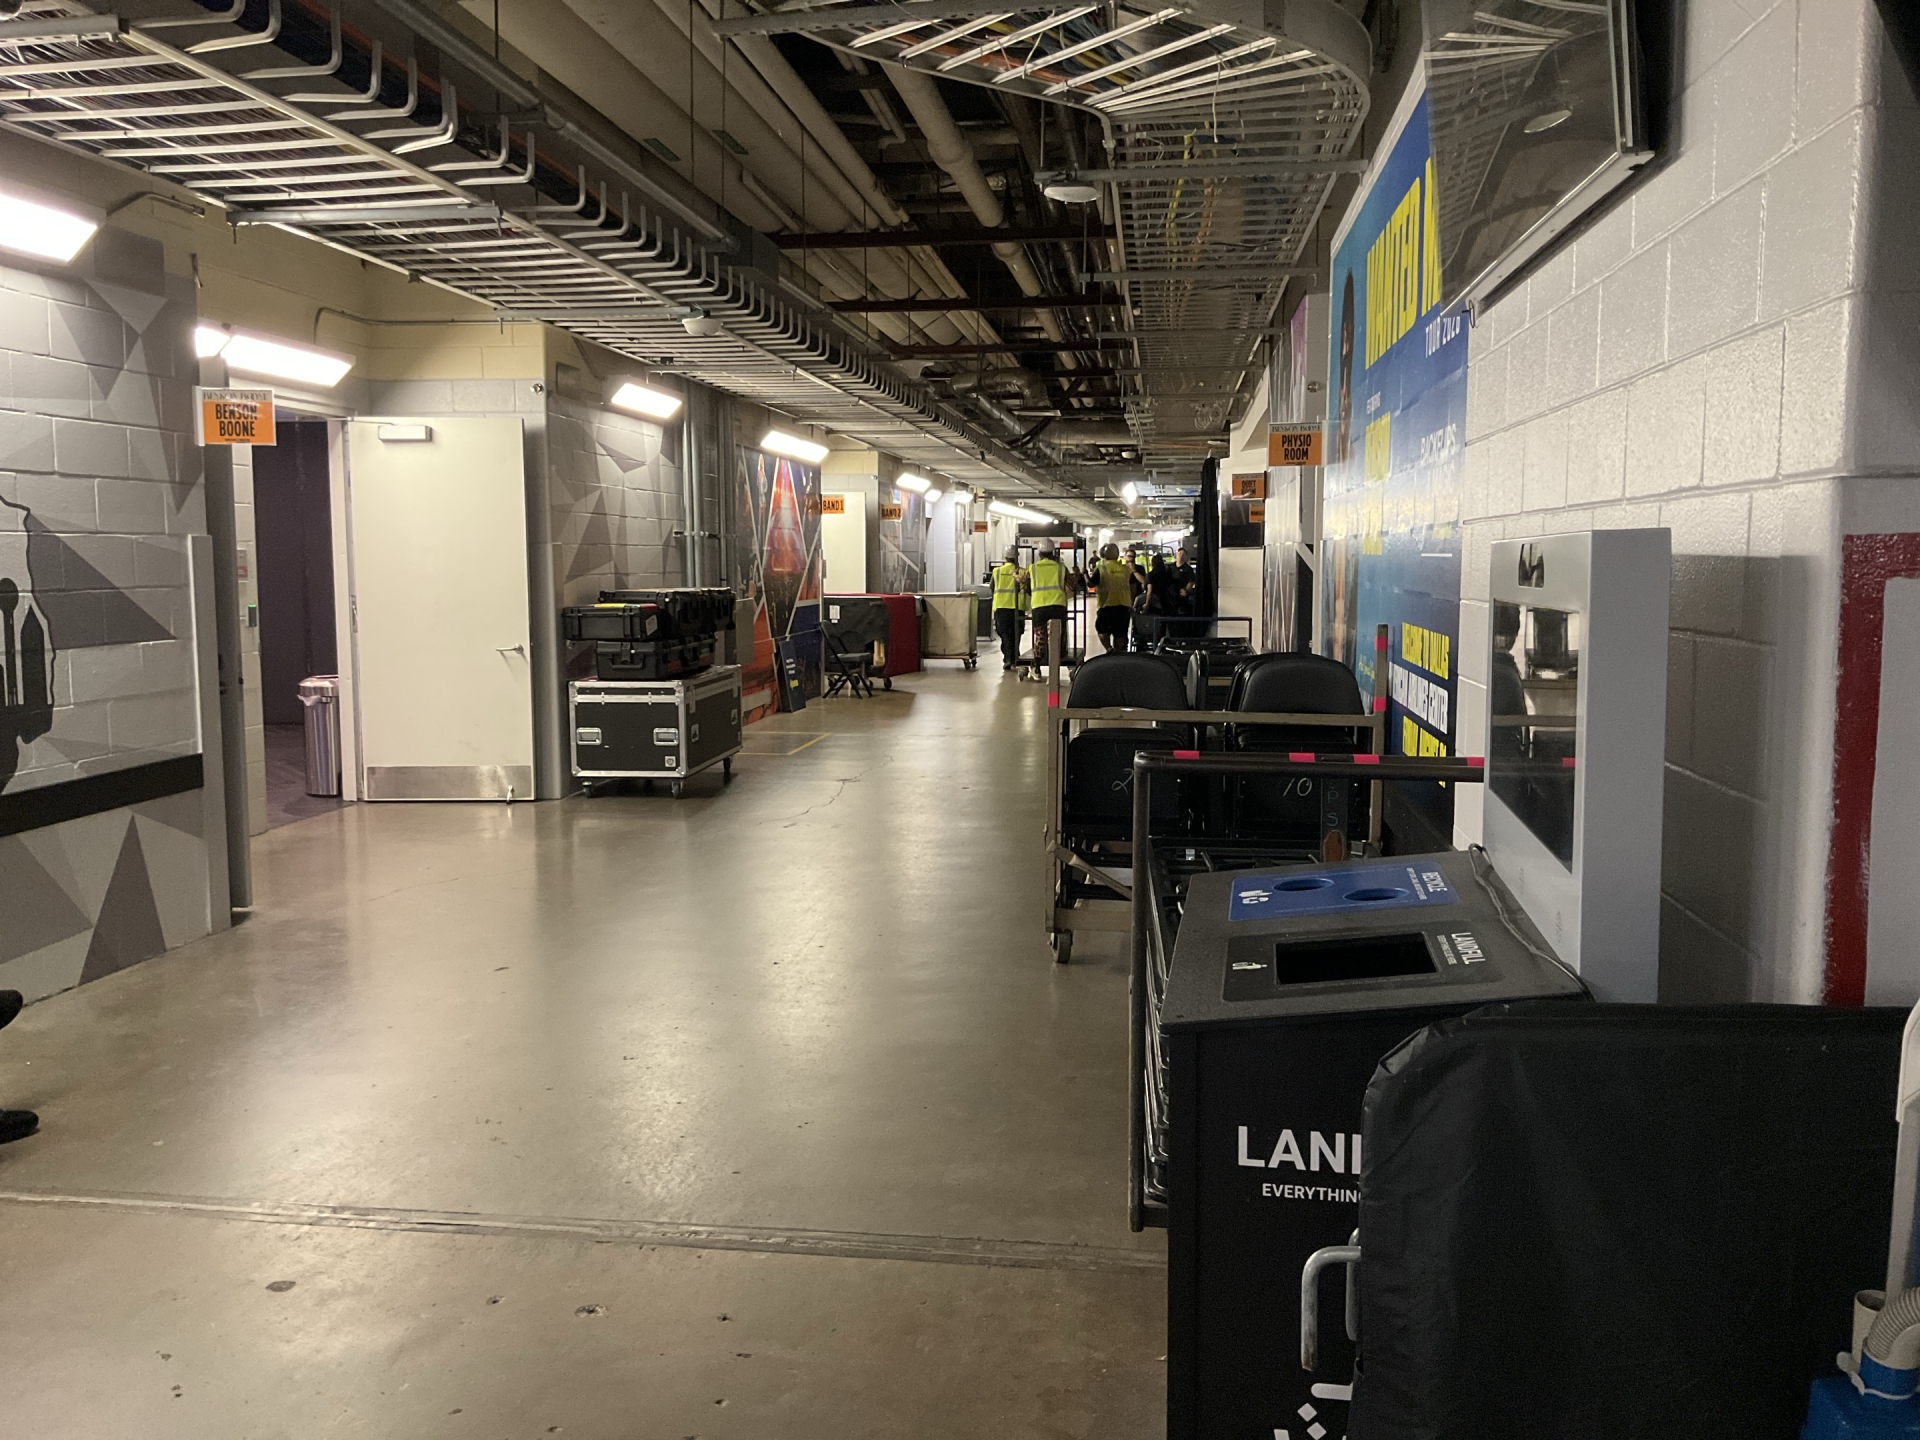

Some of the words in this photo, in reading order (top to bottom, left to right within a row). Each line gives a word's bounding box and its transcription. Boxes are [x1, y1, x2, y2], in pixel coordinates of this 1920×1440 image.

[1366, 176, 1420, 370] WANTED
[1425, 316, 1440, 358] TOUR
[215, 404, 258, 420] BENSON
[219, 421, 256, 437] BOONE
[1281, 434, 1312, 448] PHYSIO
[1284, 447, 1309, 461] ROOM
[823, 500, 839, 511] BAND
[840, 500, 844, 511] 1
[881, 508, 897, 518] BAND
[1282, 777, 1313, 798] 10
[1451, 932, 1485, 965] LANDFILL
[1262, 1183, 1361, 1203] EVERYTHIN
